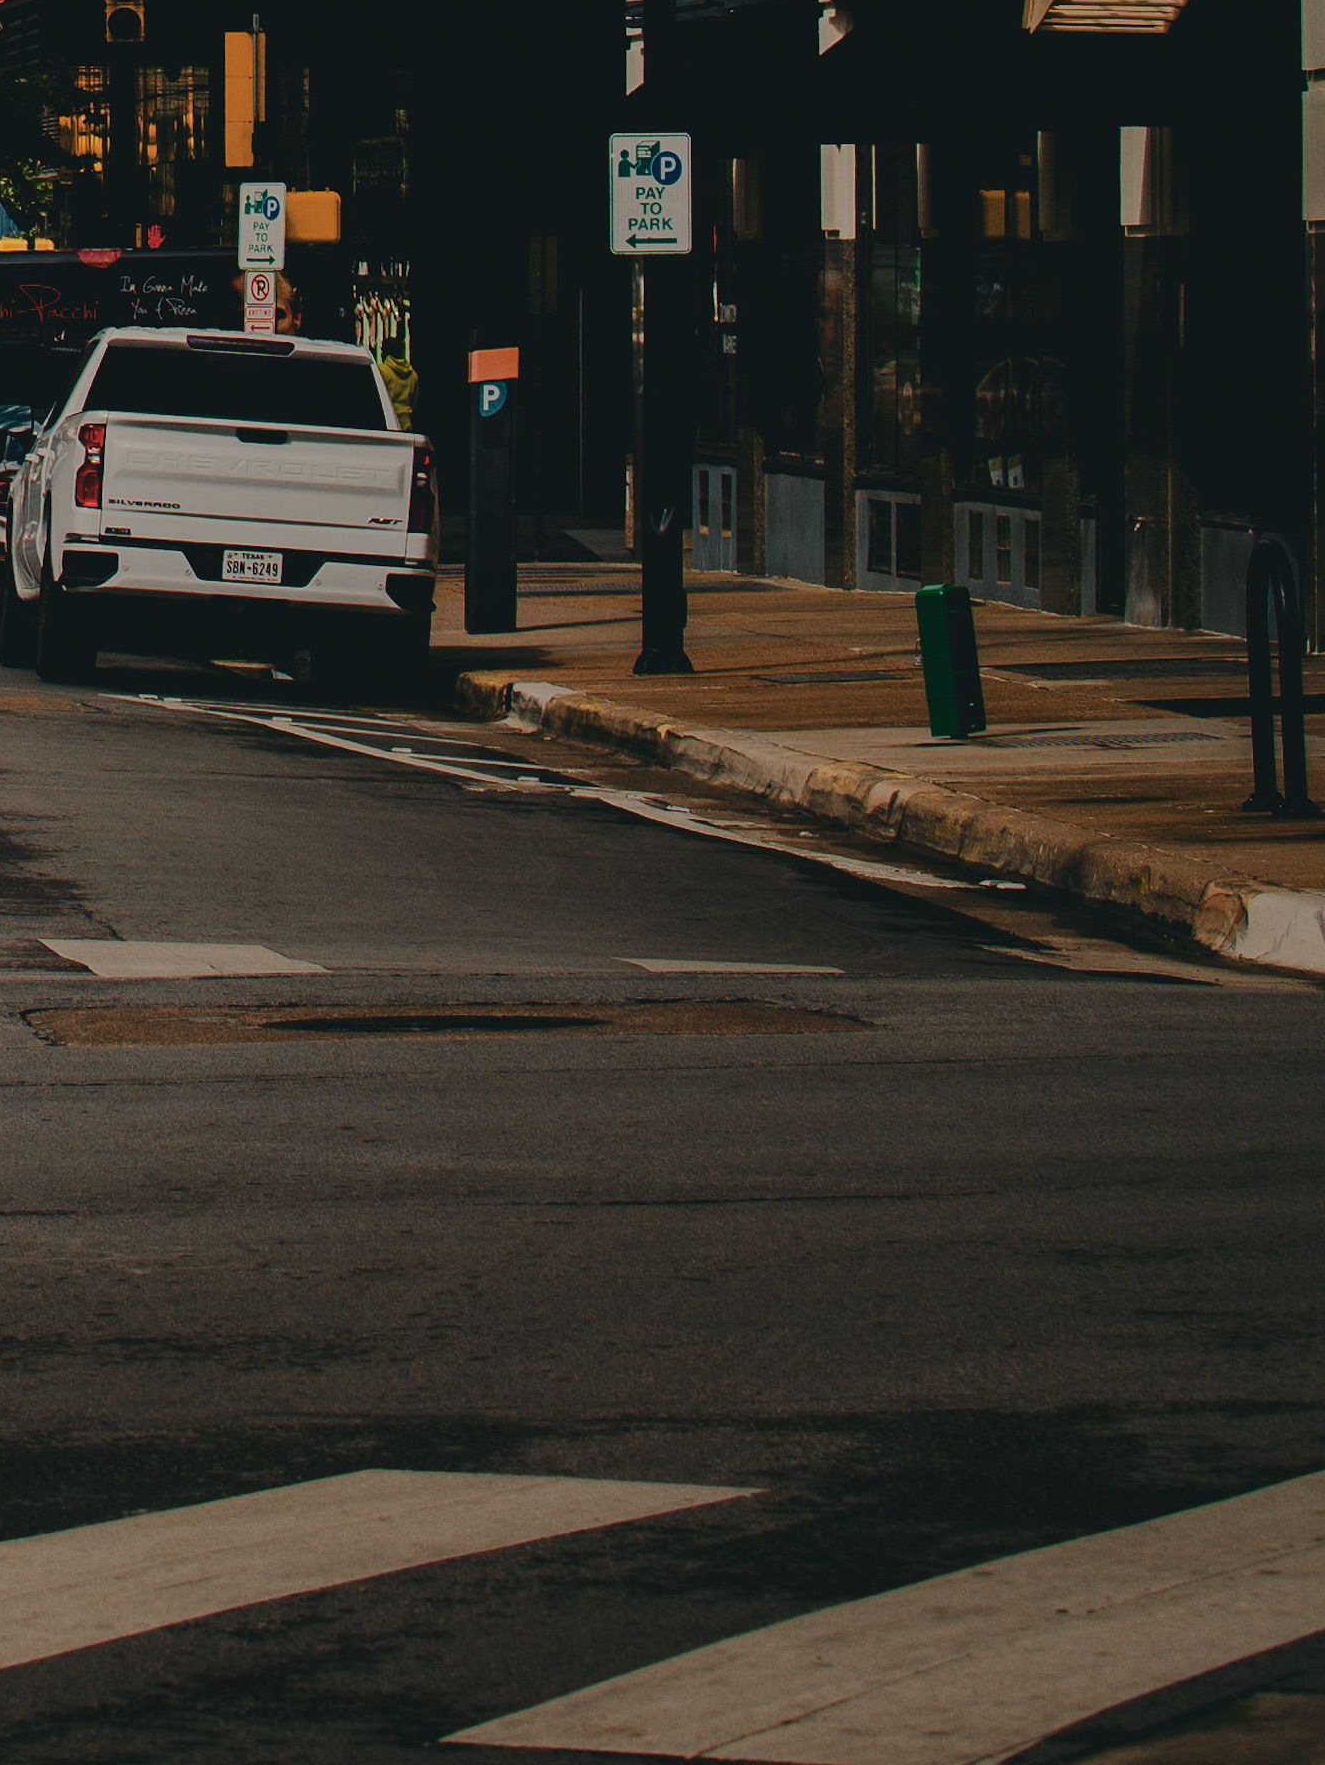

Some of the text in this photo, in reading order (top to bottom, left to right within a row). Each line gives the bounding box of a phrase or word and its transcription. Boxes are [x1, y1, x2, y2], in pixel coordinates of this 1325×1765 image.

[635, 186, 666, 200] PAY
[639, 201, 663, 216] TO
[253, 221, 270, 231] PAY
[628, 217, 673, 231] PARK
[255, 232, 269, 242] TO
[248, 244, 274, 254] PARK
[483, 384, 501, 411] P
[125, 451, 391, 485] CHEVROLET
[108, 498, 181, 510] SILVERADO
[241, 552, 265, 560] TEXAS
